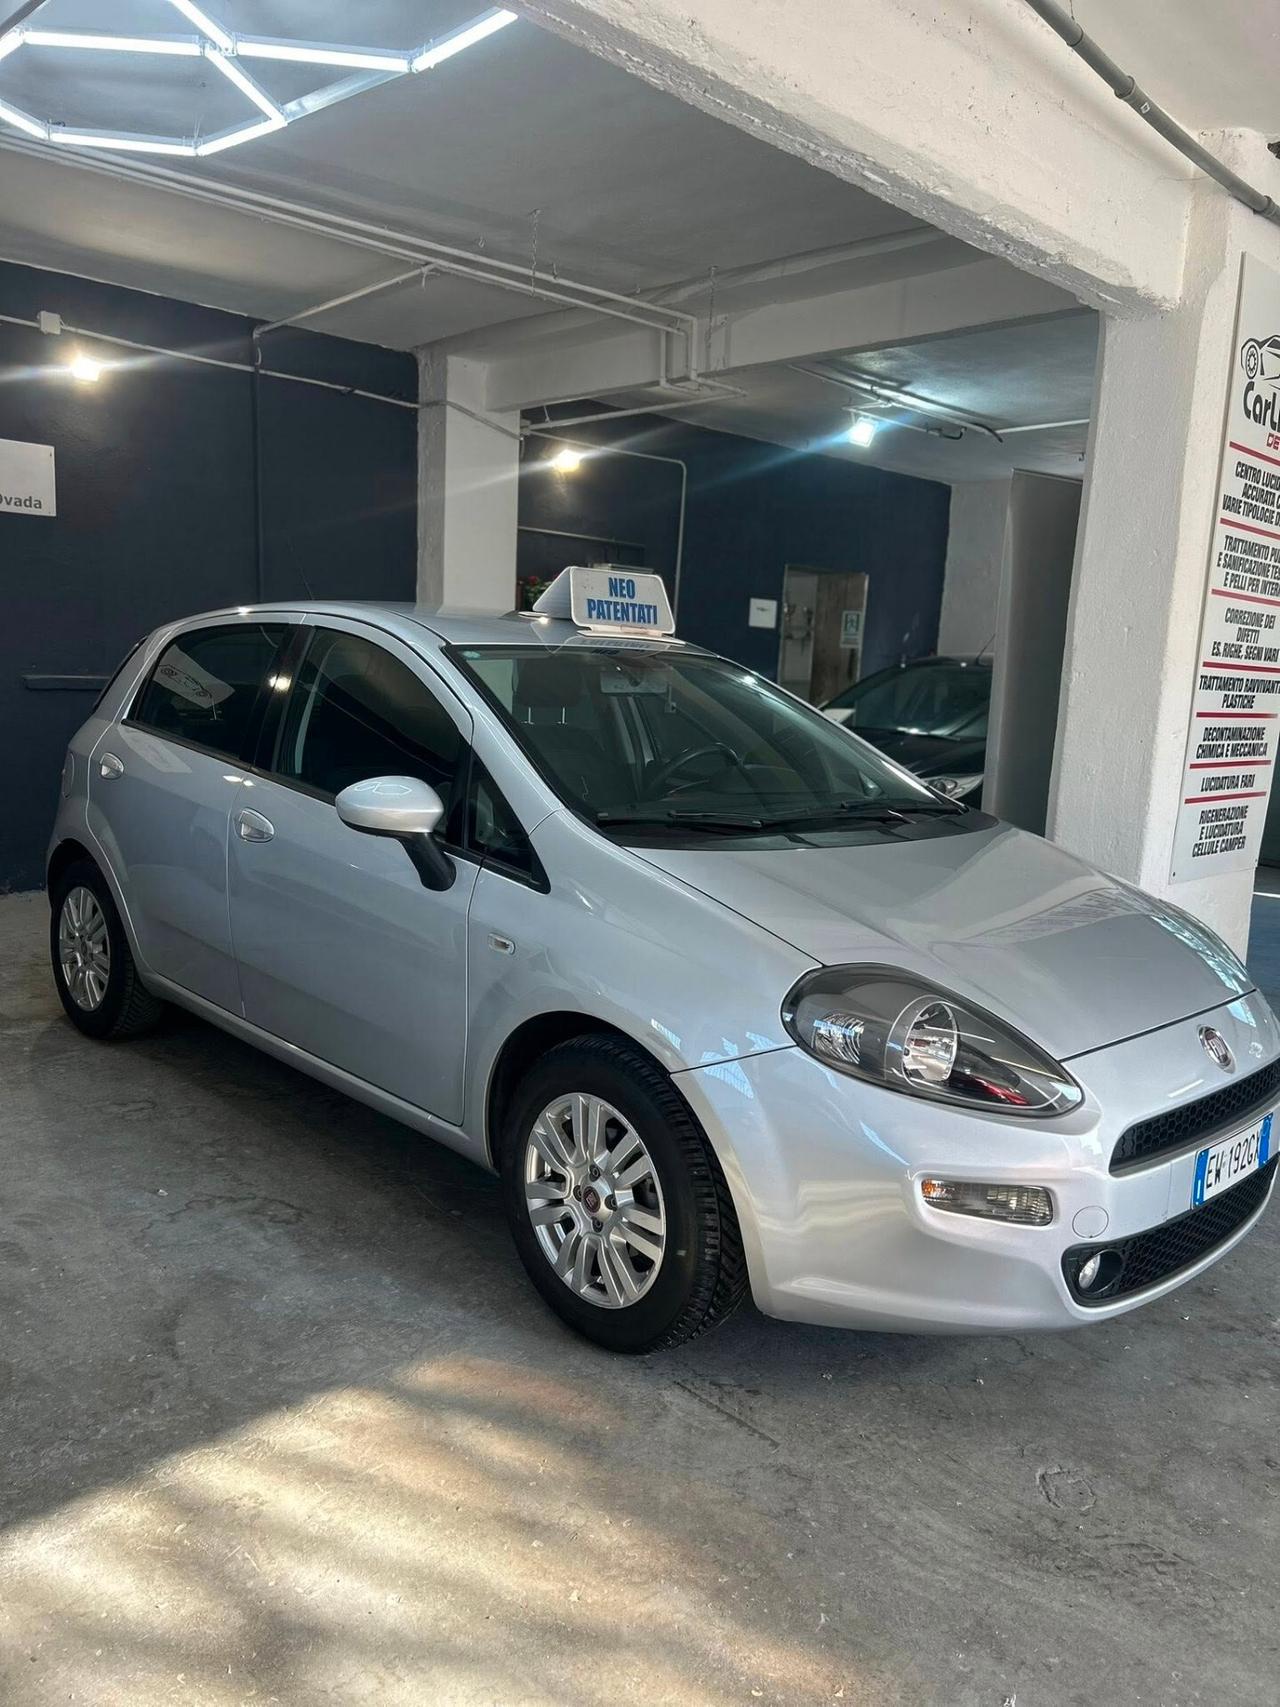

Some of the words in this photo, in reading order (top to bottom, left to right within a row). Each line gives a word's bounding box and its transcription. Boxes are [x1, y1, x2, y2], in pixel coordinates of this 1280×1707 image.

[1235, 461, 1262, 484] CENTRO
[1242, 483, 1276, 507] ACCURATA
[1222, 494, 1242, 514] VARIE
[1242, 501, 1275, 524] TIPOLOGIE
[1224, 535, 1270, 560] TRATTAMENTO
[1217, 552, 1223, 567] E
[1222, 553, 1271, 578] SANIFICAZIONE
[608, 577, 635, 599] NEO
[1223, 572, 1229, 586] E
[1229, 573, 1248, 590] PELLI
[1247, 577, 1261, 593] PER
[1260, 580, 1280, 597] INTER
[586, 598, 658, 624] PATENTATI
[1225, 608, 1264, 627] CORREZIONE
[1264, 614, 1276, 629] DEI
[1236, 627, 1260, 643] DIFETTI
[1244, 646, 1264, 660] SEGNI
[1264, 647, 1280, 662] VARI
[1199, 675, 1244, 692] TRATTAMENTO
[1222, 694, 1256, 709] PLASTICHE
[1203, 727, 1266, 742] DECONTAMINAZIONE
[1196, 743, 1225, 759] CHIMICA
[1225, 743, 1231, 757] E
[1230, 742, 1268, 757] MECCANICA
[1201, 775, 1240, 792] LUCIDATURA
[1240, 774, 1256, 788] FARI
[1199, 805, 1249, 824] RIGENERAZIONE
[1199, 826, 1205, 840] E
[1205, 821, 1244, 840] LUCIDATURA
[1192, 840, 1219, 857] CELLULE
[1220, 836, 1246, 852] CAMPER
